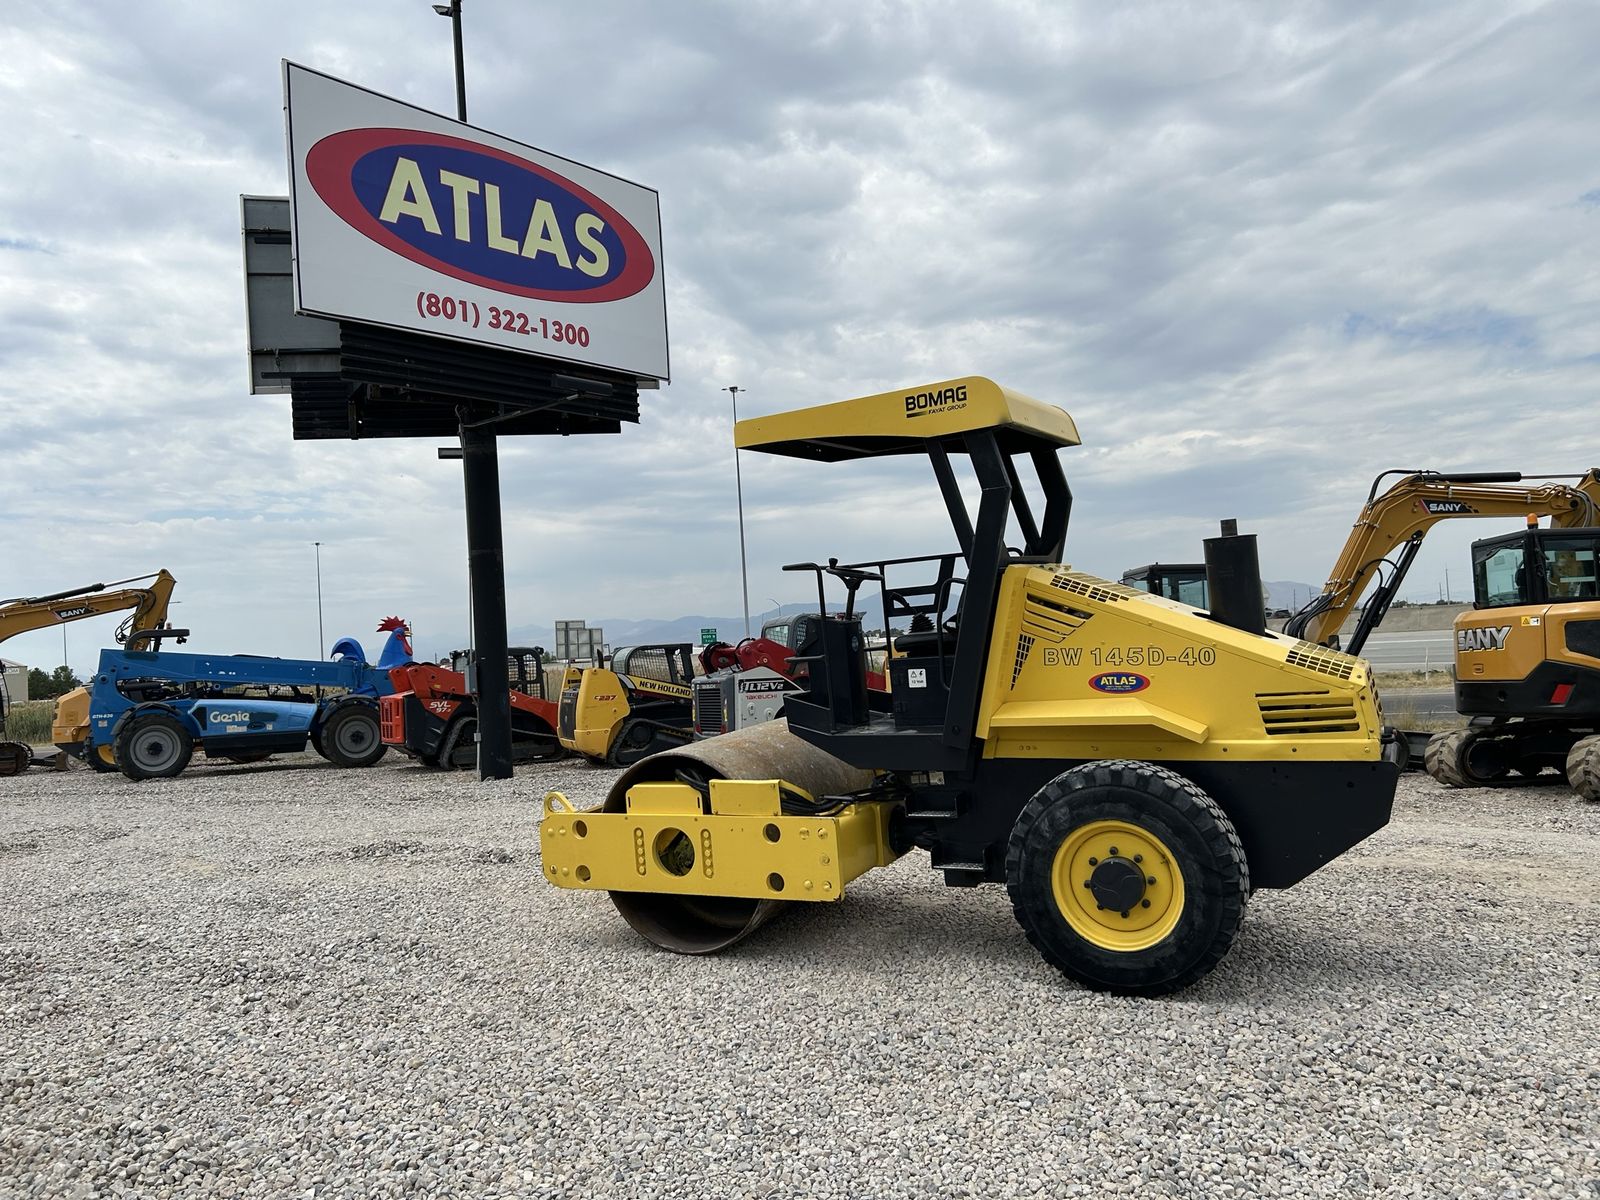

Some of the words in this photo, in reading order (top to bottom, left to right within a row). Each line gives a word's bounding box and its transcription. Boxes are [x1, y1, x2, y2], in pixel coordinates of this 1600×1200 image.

[378, 156, 611, 278] ATLAS
[417, 291, 480, 328] (801)
[488, 306, 590, 348] 322-1300
[905, 385, 967, 411] BOMAG
[928, 406, 946, 415] FAYAT
[946, 402, 967, 412] GROUP
[1429, 503, 1462, 512] SANY
[60, 608, 86, 618] SANY
[1457, 626, 1512, 651] SANY
[1043, 648, 1082, 666] BW
[1090, 647, 1216, 666] 145D-40
[1100, 676, 1137, 685] ATLAS
[639, 680, 657, 690] NEW
[657, 684, 691, 697] HOLLAND
[429, 701, 451, 709] SVL
[209, 710, 250, 723] Genie
